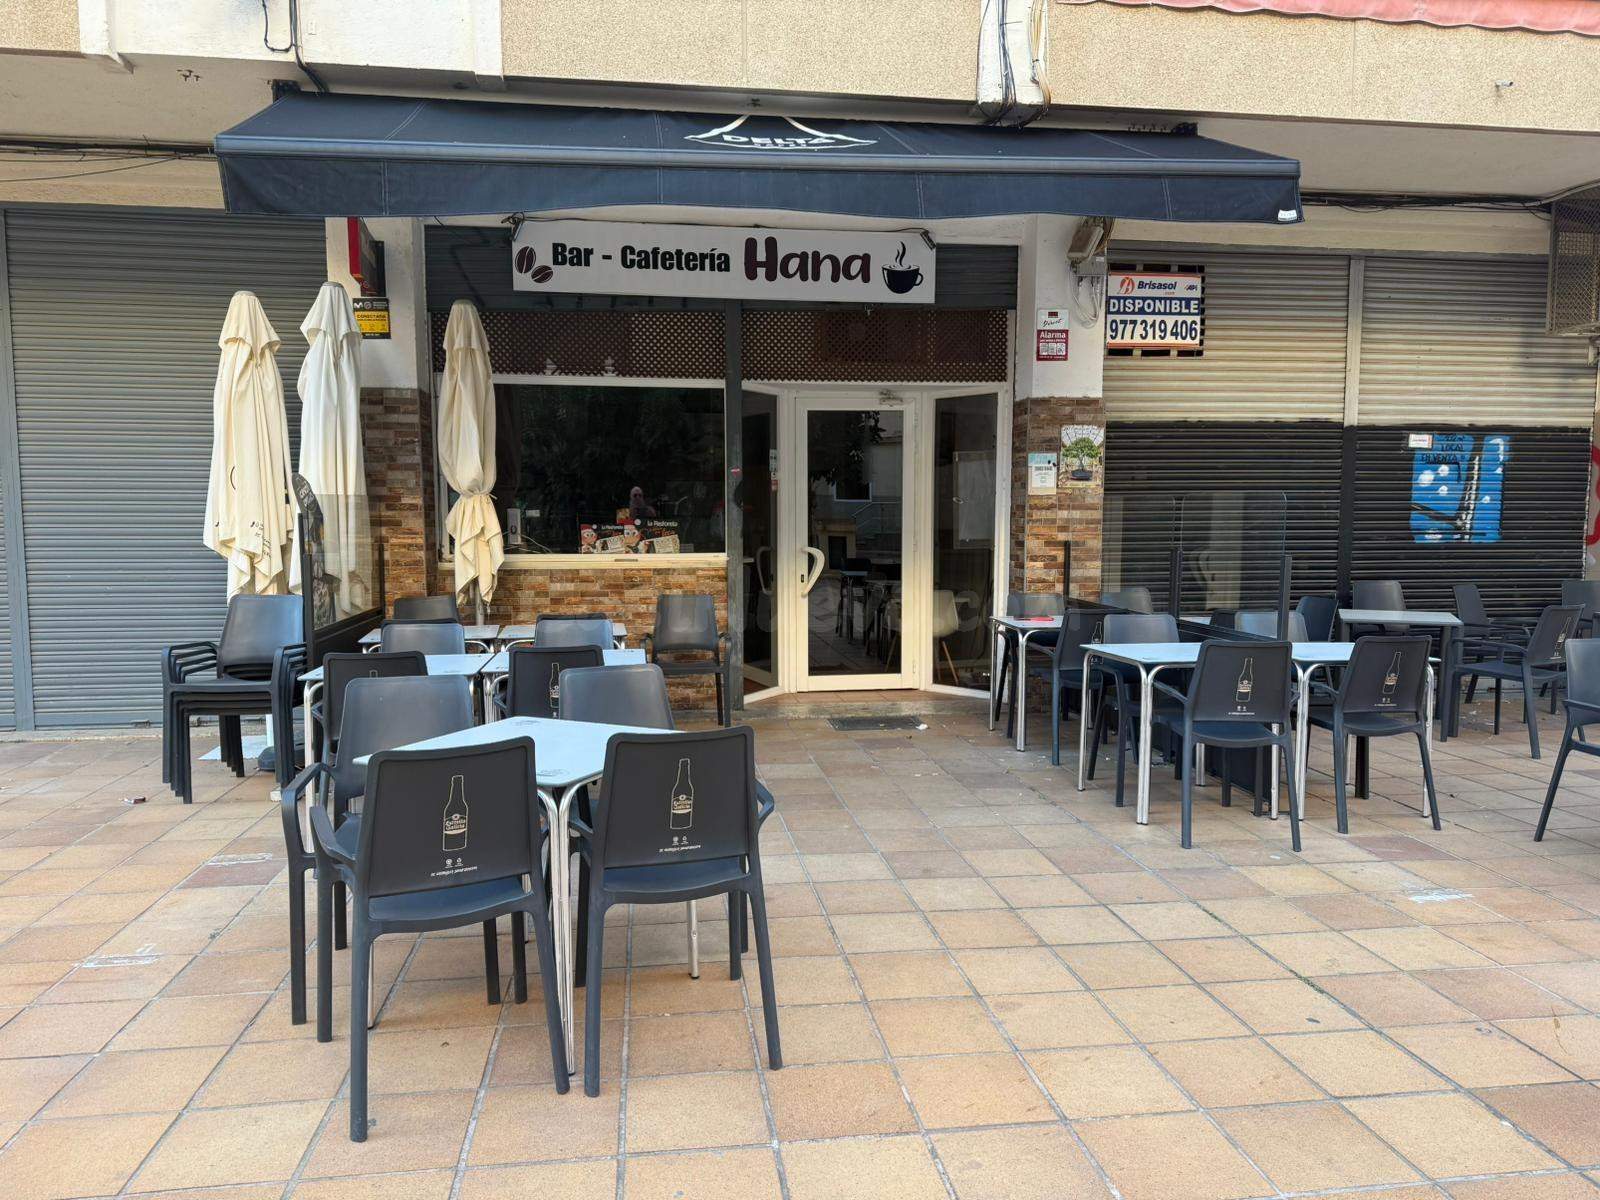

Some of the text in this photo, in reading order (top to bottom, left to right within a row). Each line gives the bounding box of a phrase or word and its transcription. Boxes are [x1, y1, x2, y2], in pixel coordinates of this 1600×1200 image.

[722, 134, 836, 145] DELTA
[552, 242, 594, 267] Bar
[620, 245, 730, 273] Cafetería
[744, 236, 871, 284] Hana
[1137, 280, 1177, 290] Brisasol
[1109, 298, 1199, 314] DISPONIBLE
